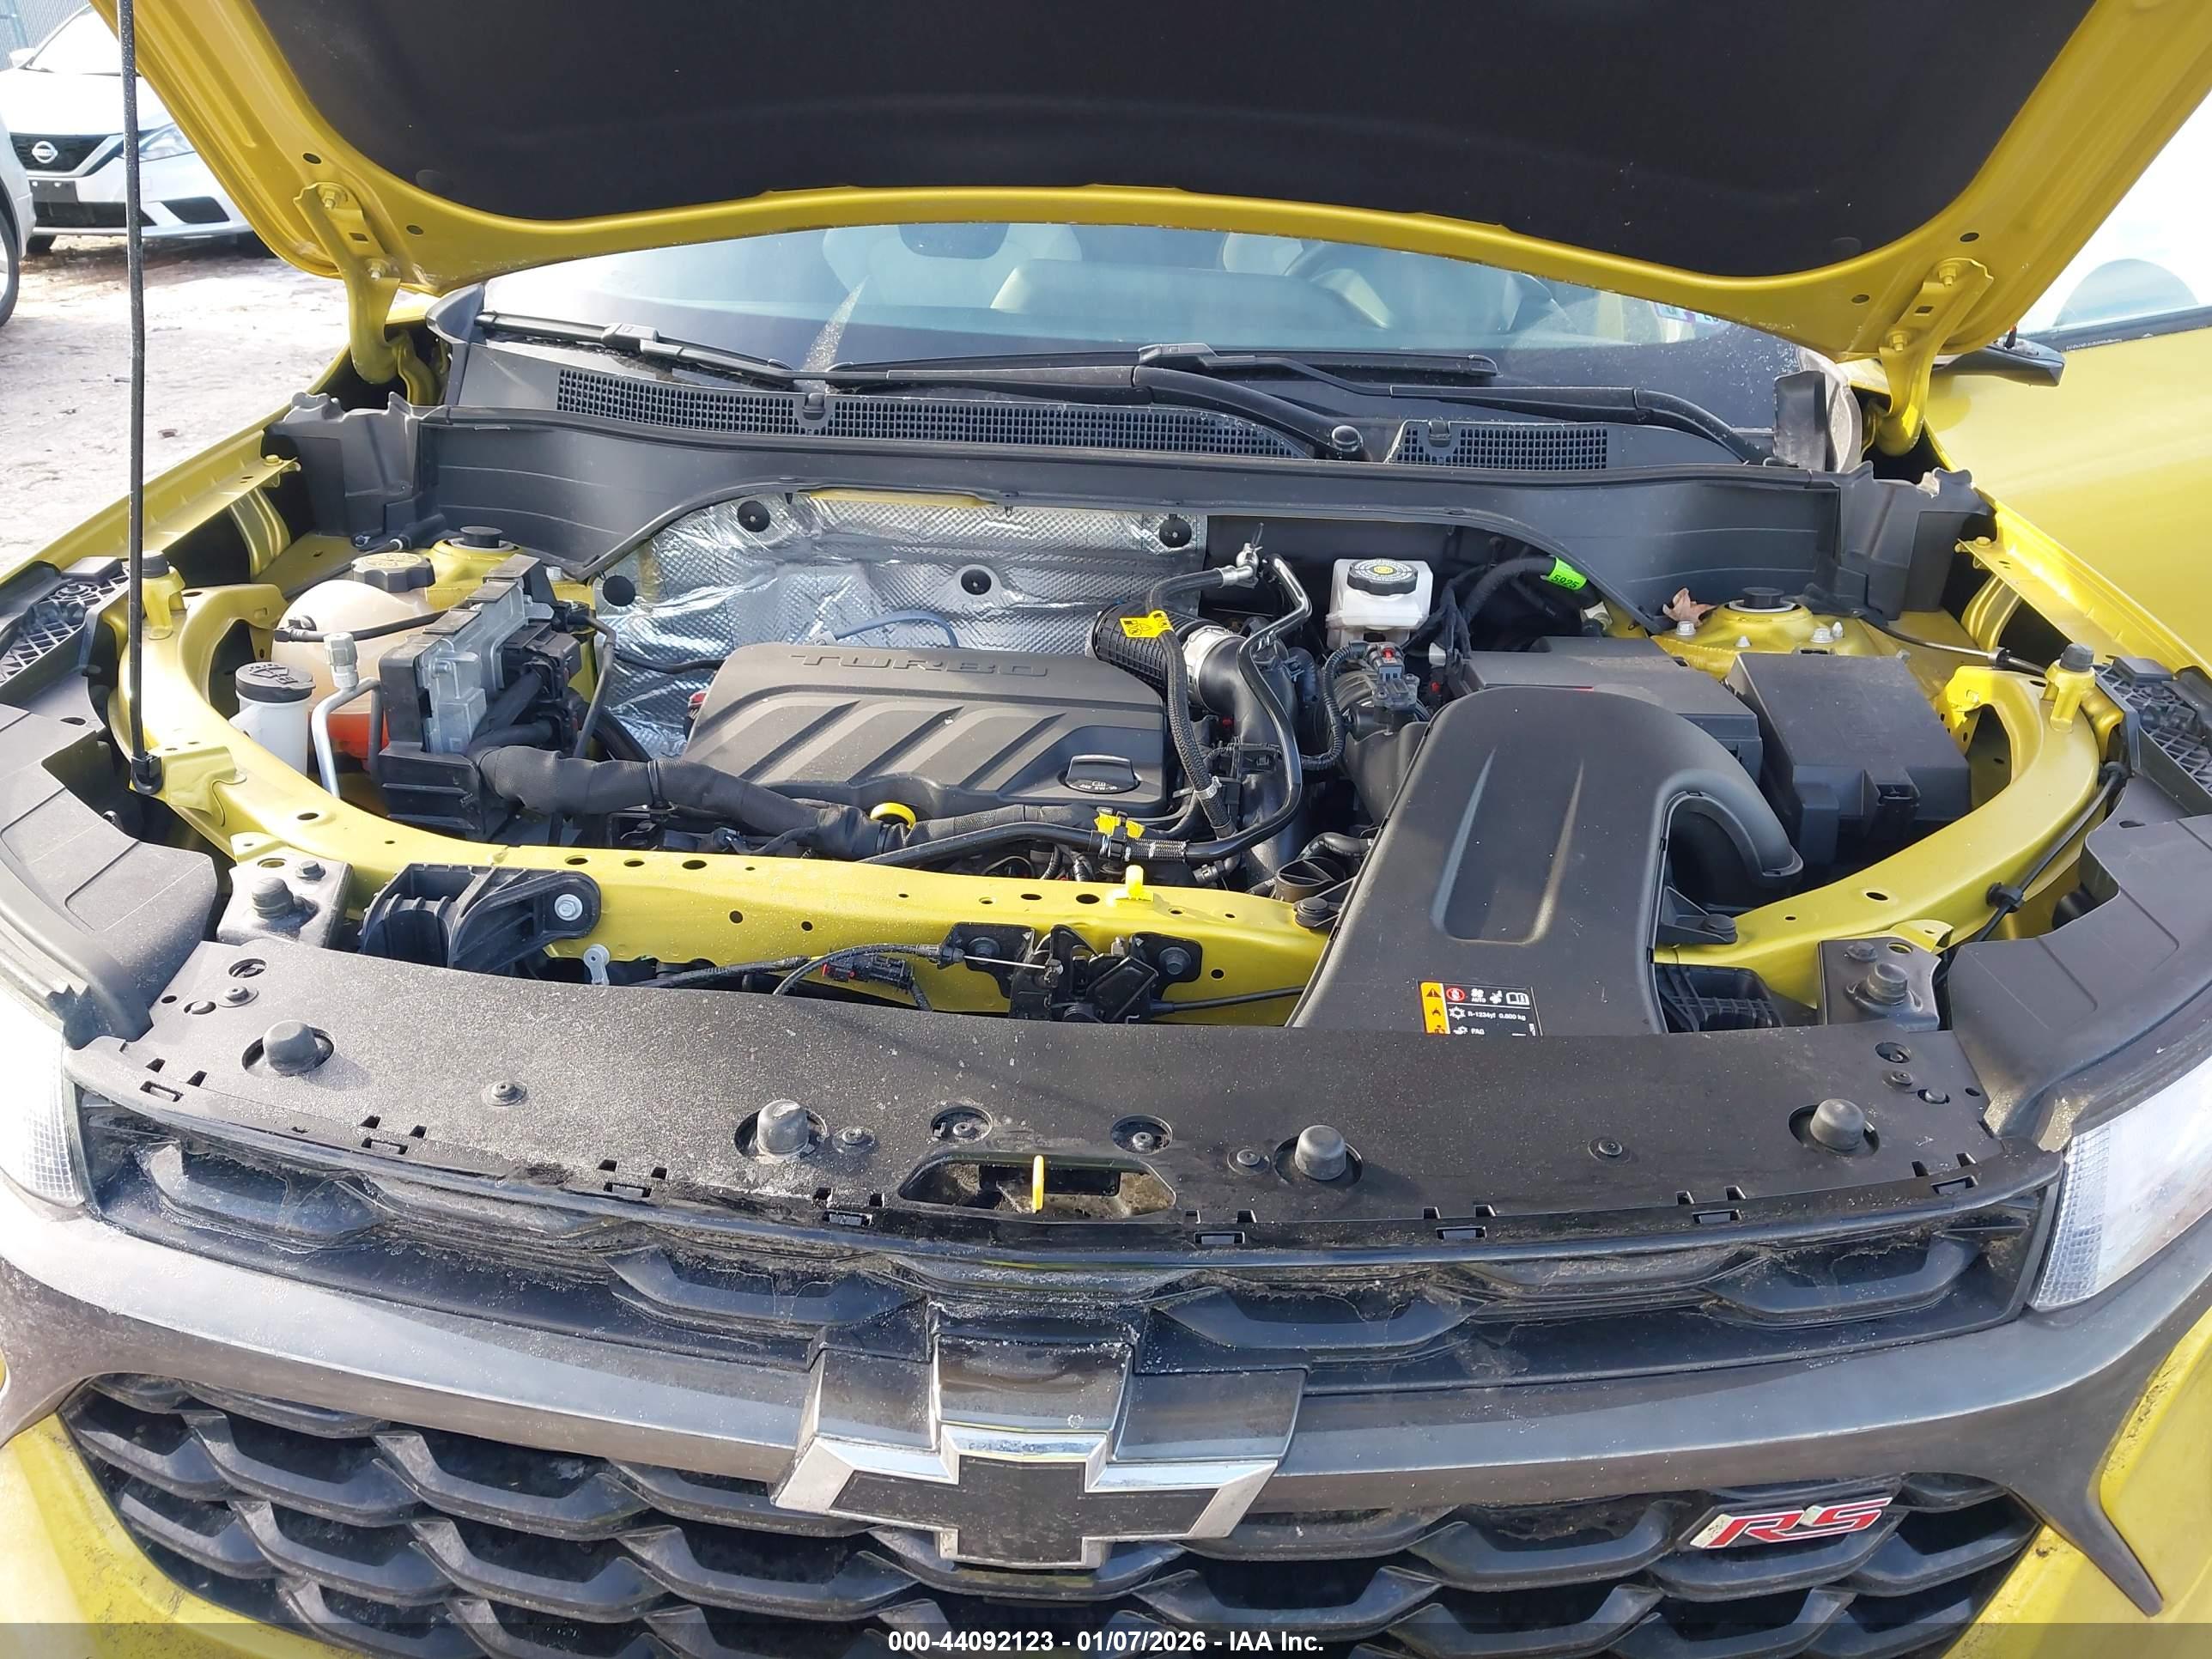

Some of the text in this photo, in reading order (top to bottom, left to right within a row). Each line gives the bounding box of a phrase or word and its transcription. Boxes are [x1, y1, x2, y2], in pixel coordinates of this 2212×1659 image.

[1551, 574, 1579, 588] 5925
[790, 653, 1048, 677] TURBO
[1690, 1498, 1893, 1549] RS
